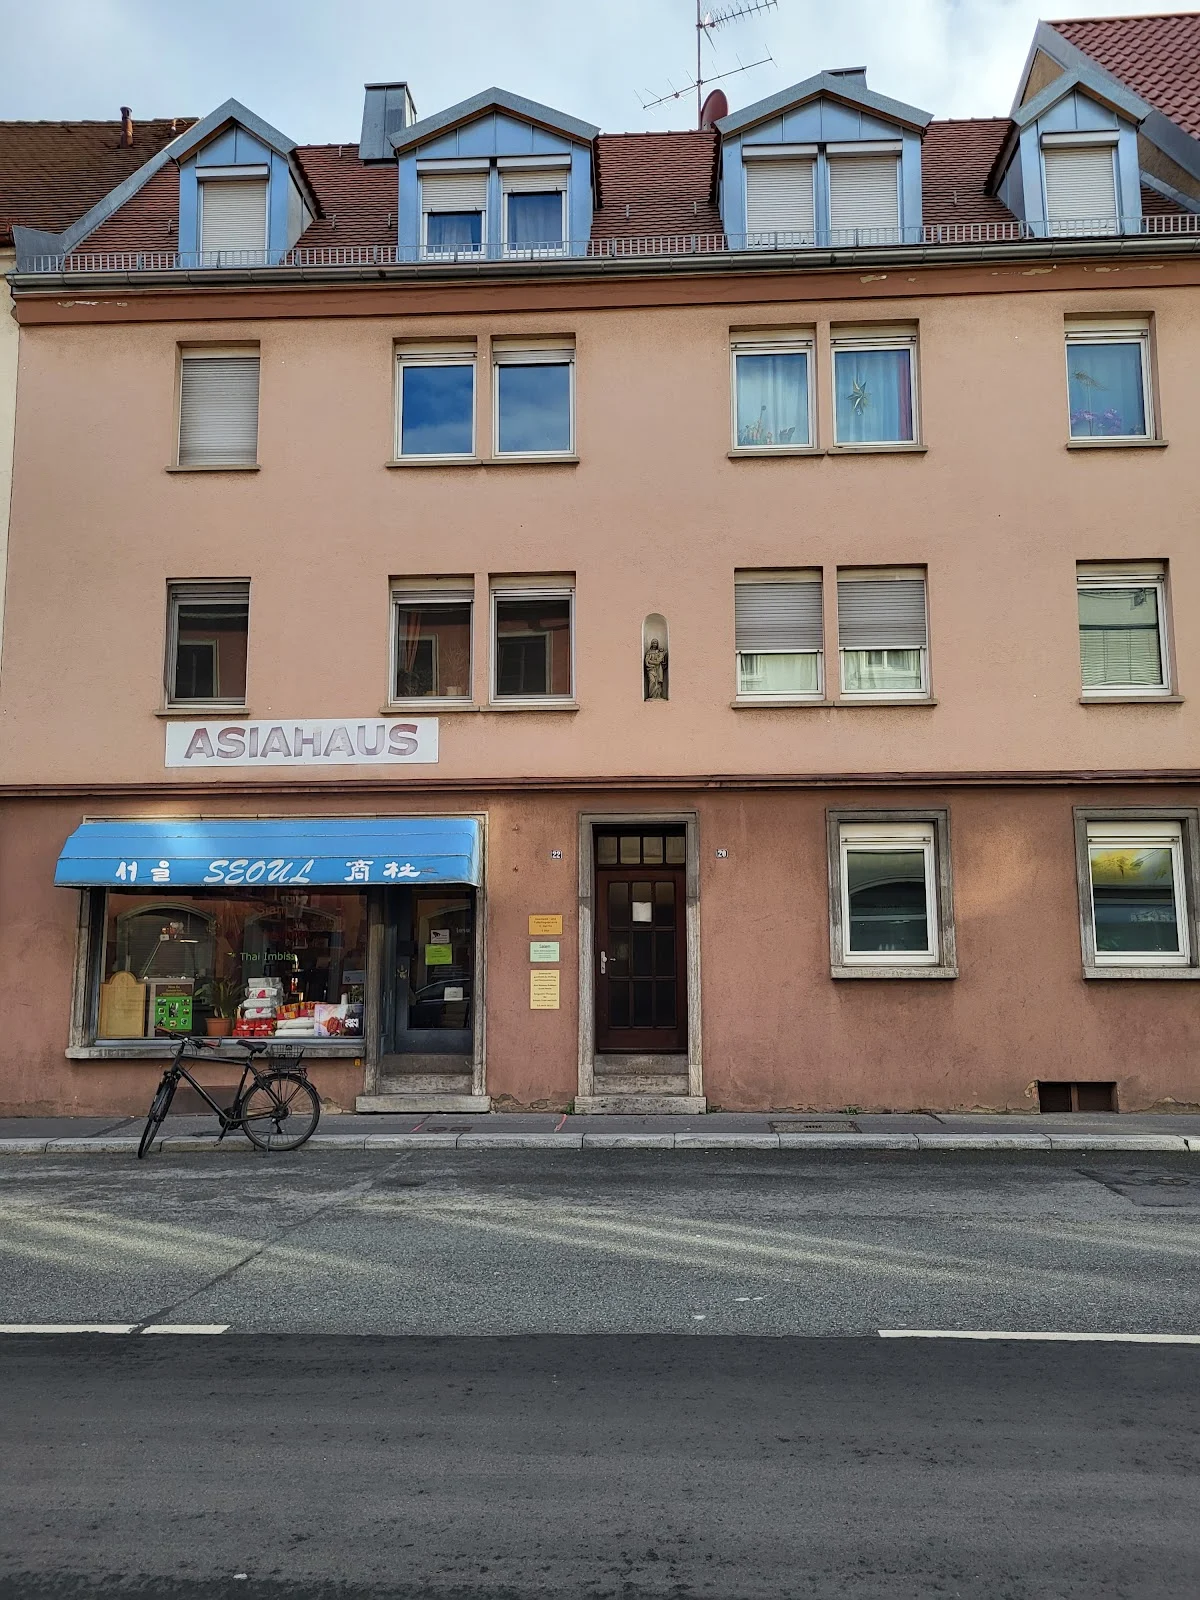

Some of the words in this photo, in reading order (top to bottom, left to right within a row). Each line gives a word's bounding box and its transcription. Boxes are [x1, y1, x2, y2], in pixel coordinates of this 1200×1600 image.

[184, 723, 419, 759] ASIAHAUS
[552, 850, 561, 859] 22
[203, 859, 315, 884] SEOUL
[240, 952, 260, 962] Thai
[263, 952, 296, 962] Imbiss
